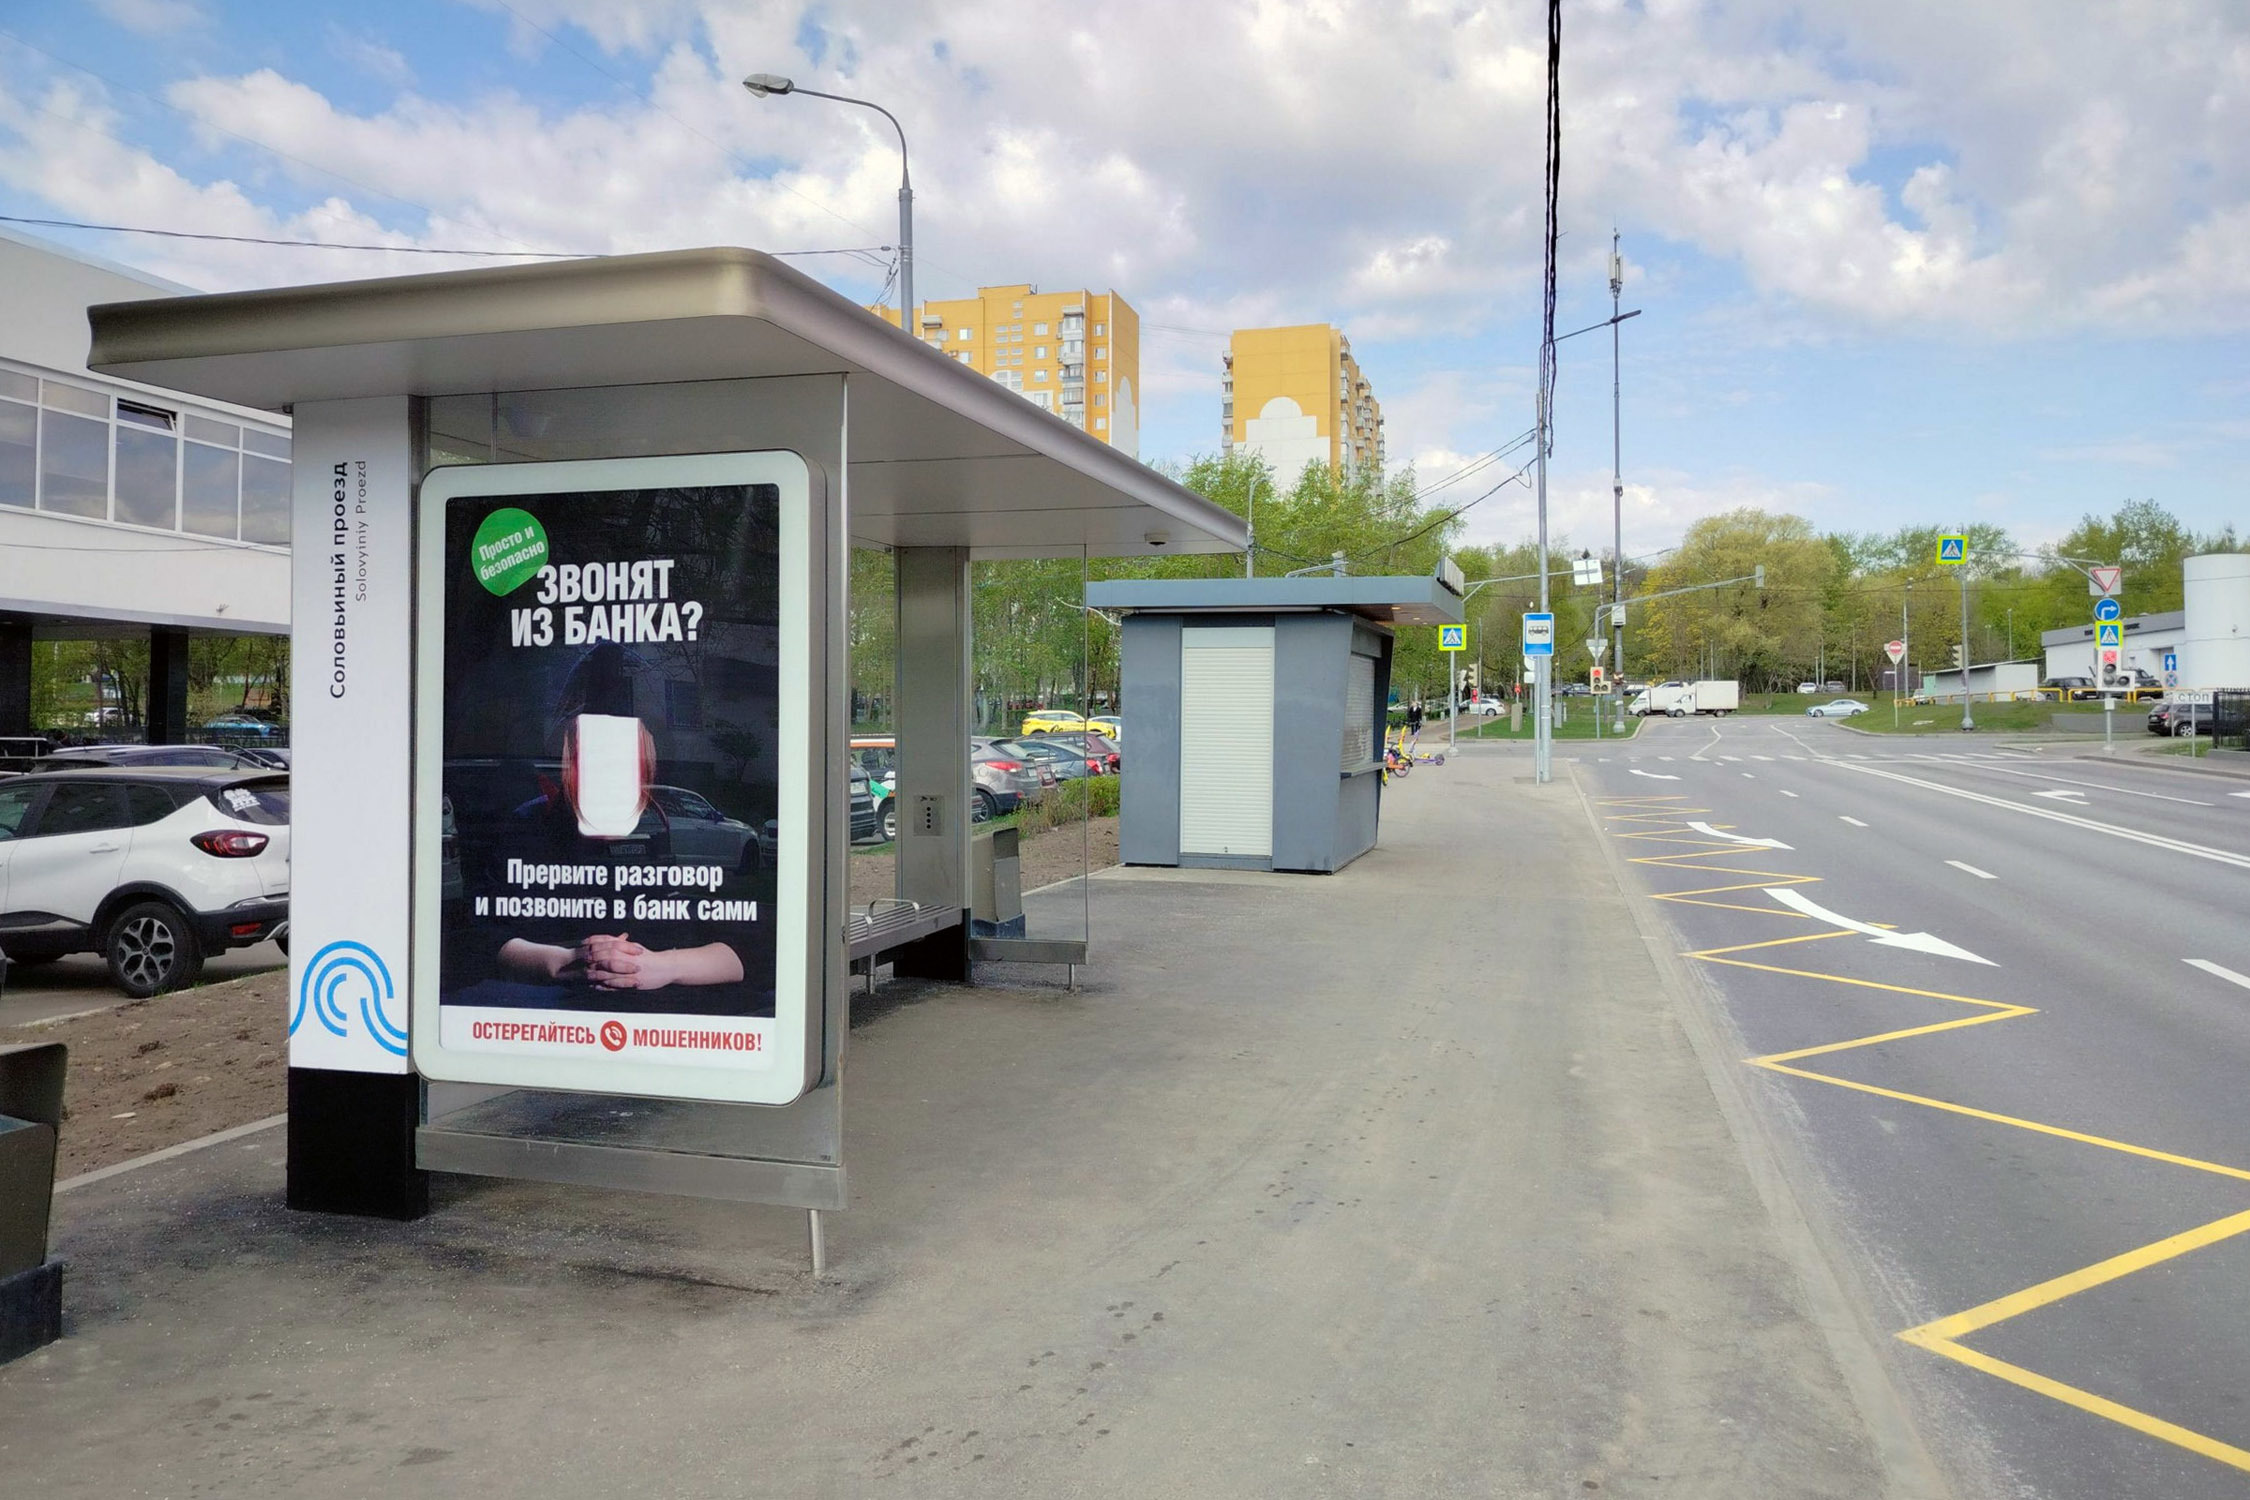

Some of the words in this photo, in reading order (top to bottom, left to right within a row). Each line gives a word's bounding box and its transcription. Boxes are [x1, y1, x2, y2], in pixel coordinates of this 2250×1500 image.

[333, 461, 349, 546] проезд
[355, 460, 367, 514] Proezd
[355, 520, 369, 602] Solovyiniy
[479, 532, 523, 561] Просто
[524, 526, 535, 539] и
[480, 541, 546, 580] безопасно
[536, 560, 675, 605] ЗВОНЯТ
[330, 552, 346, 699] Соловьиный
[511, 607, 555, 647] ИЗ
[565, 600, 704, 645] БАНКА?
[507, 859, 608, 890] Прервите
[614, 865, 723, 893] разговор
[475, 896, 489, 917] и
[495, 896, 607, 920] позвоните
[613, 899, 627, 920] в
[633, 893, 691, 921] банк
[697, 899, 758, 922] сами
[472, 1019, 596, 1045] ОСТЕРЕГАЙТЕСЬ
[632, 1028, 762, 1052] МОШЕННИКОВ!
